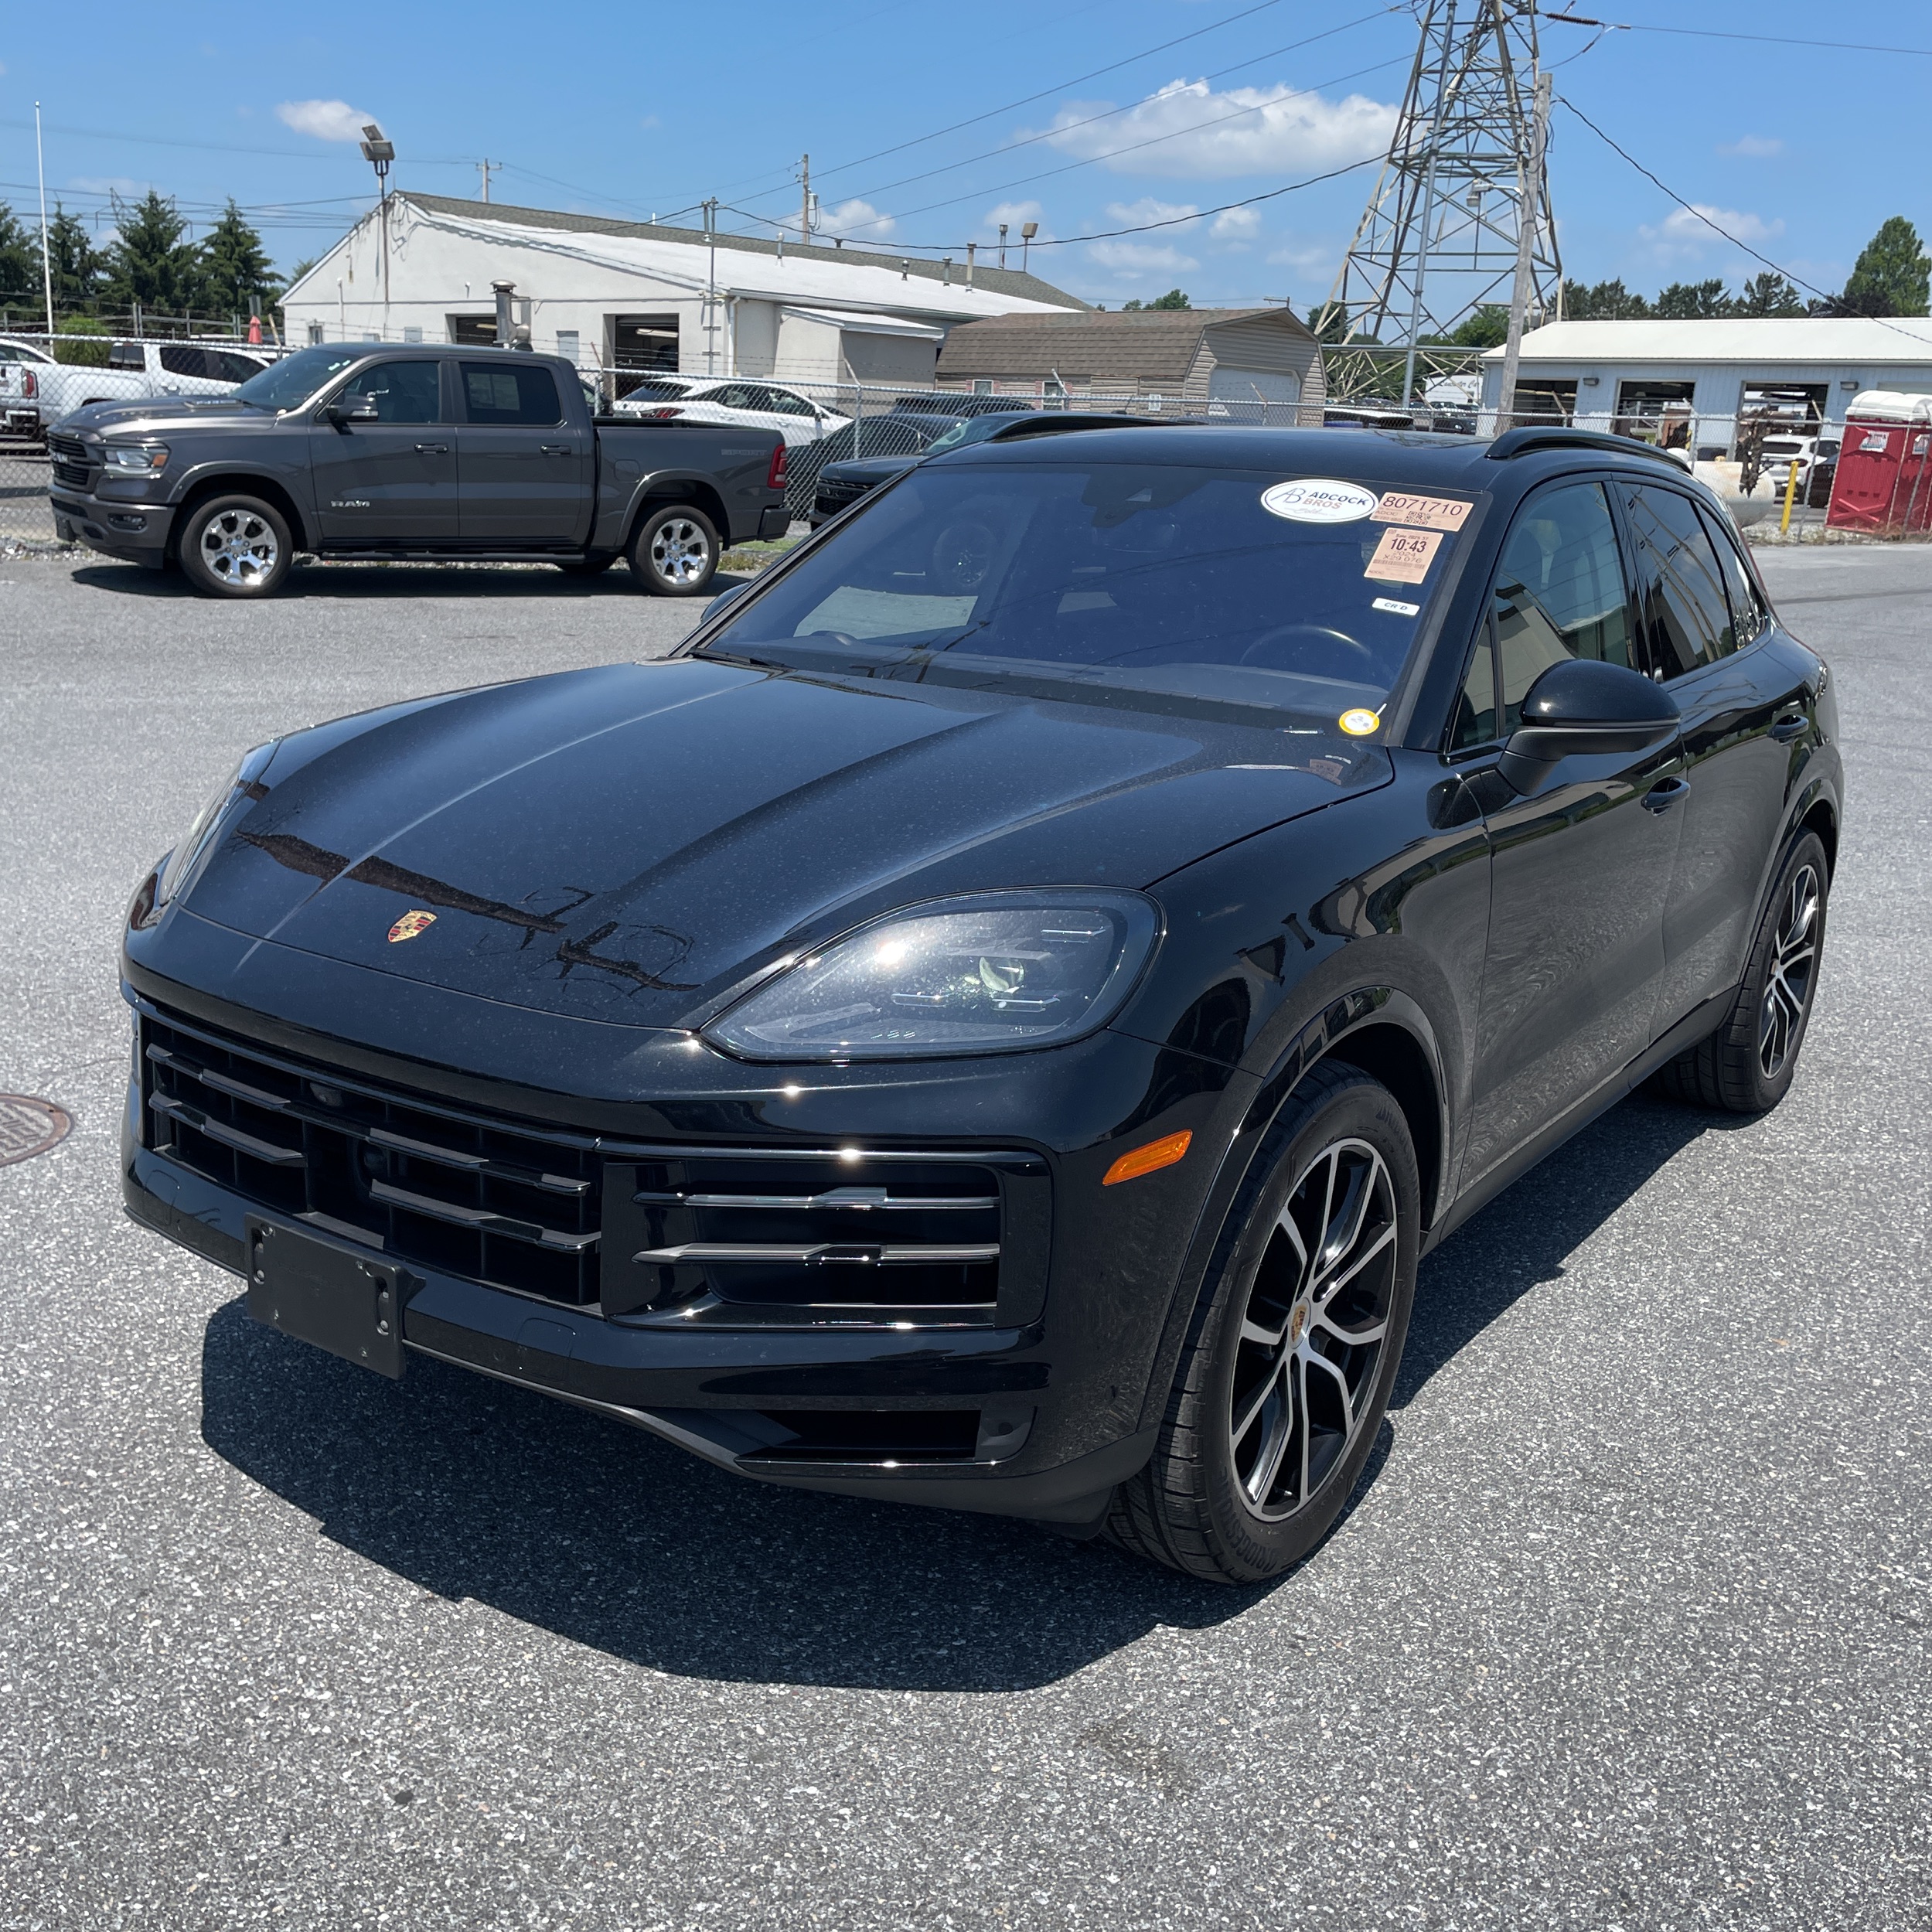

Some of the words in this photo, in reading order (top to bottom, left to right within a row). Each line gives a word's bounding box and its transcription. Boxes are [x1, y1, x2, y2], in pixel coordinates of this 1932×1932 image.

[1302, 498, 1343, 509] BROS
[1308, 491, 1370, 506] ADCOCK
[1382, 496, 1463, 516] 8071710
[1391, 538, 1427, 553] 10:43
